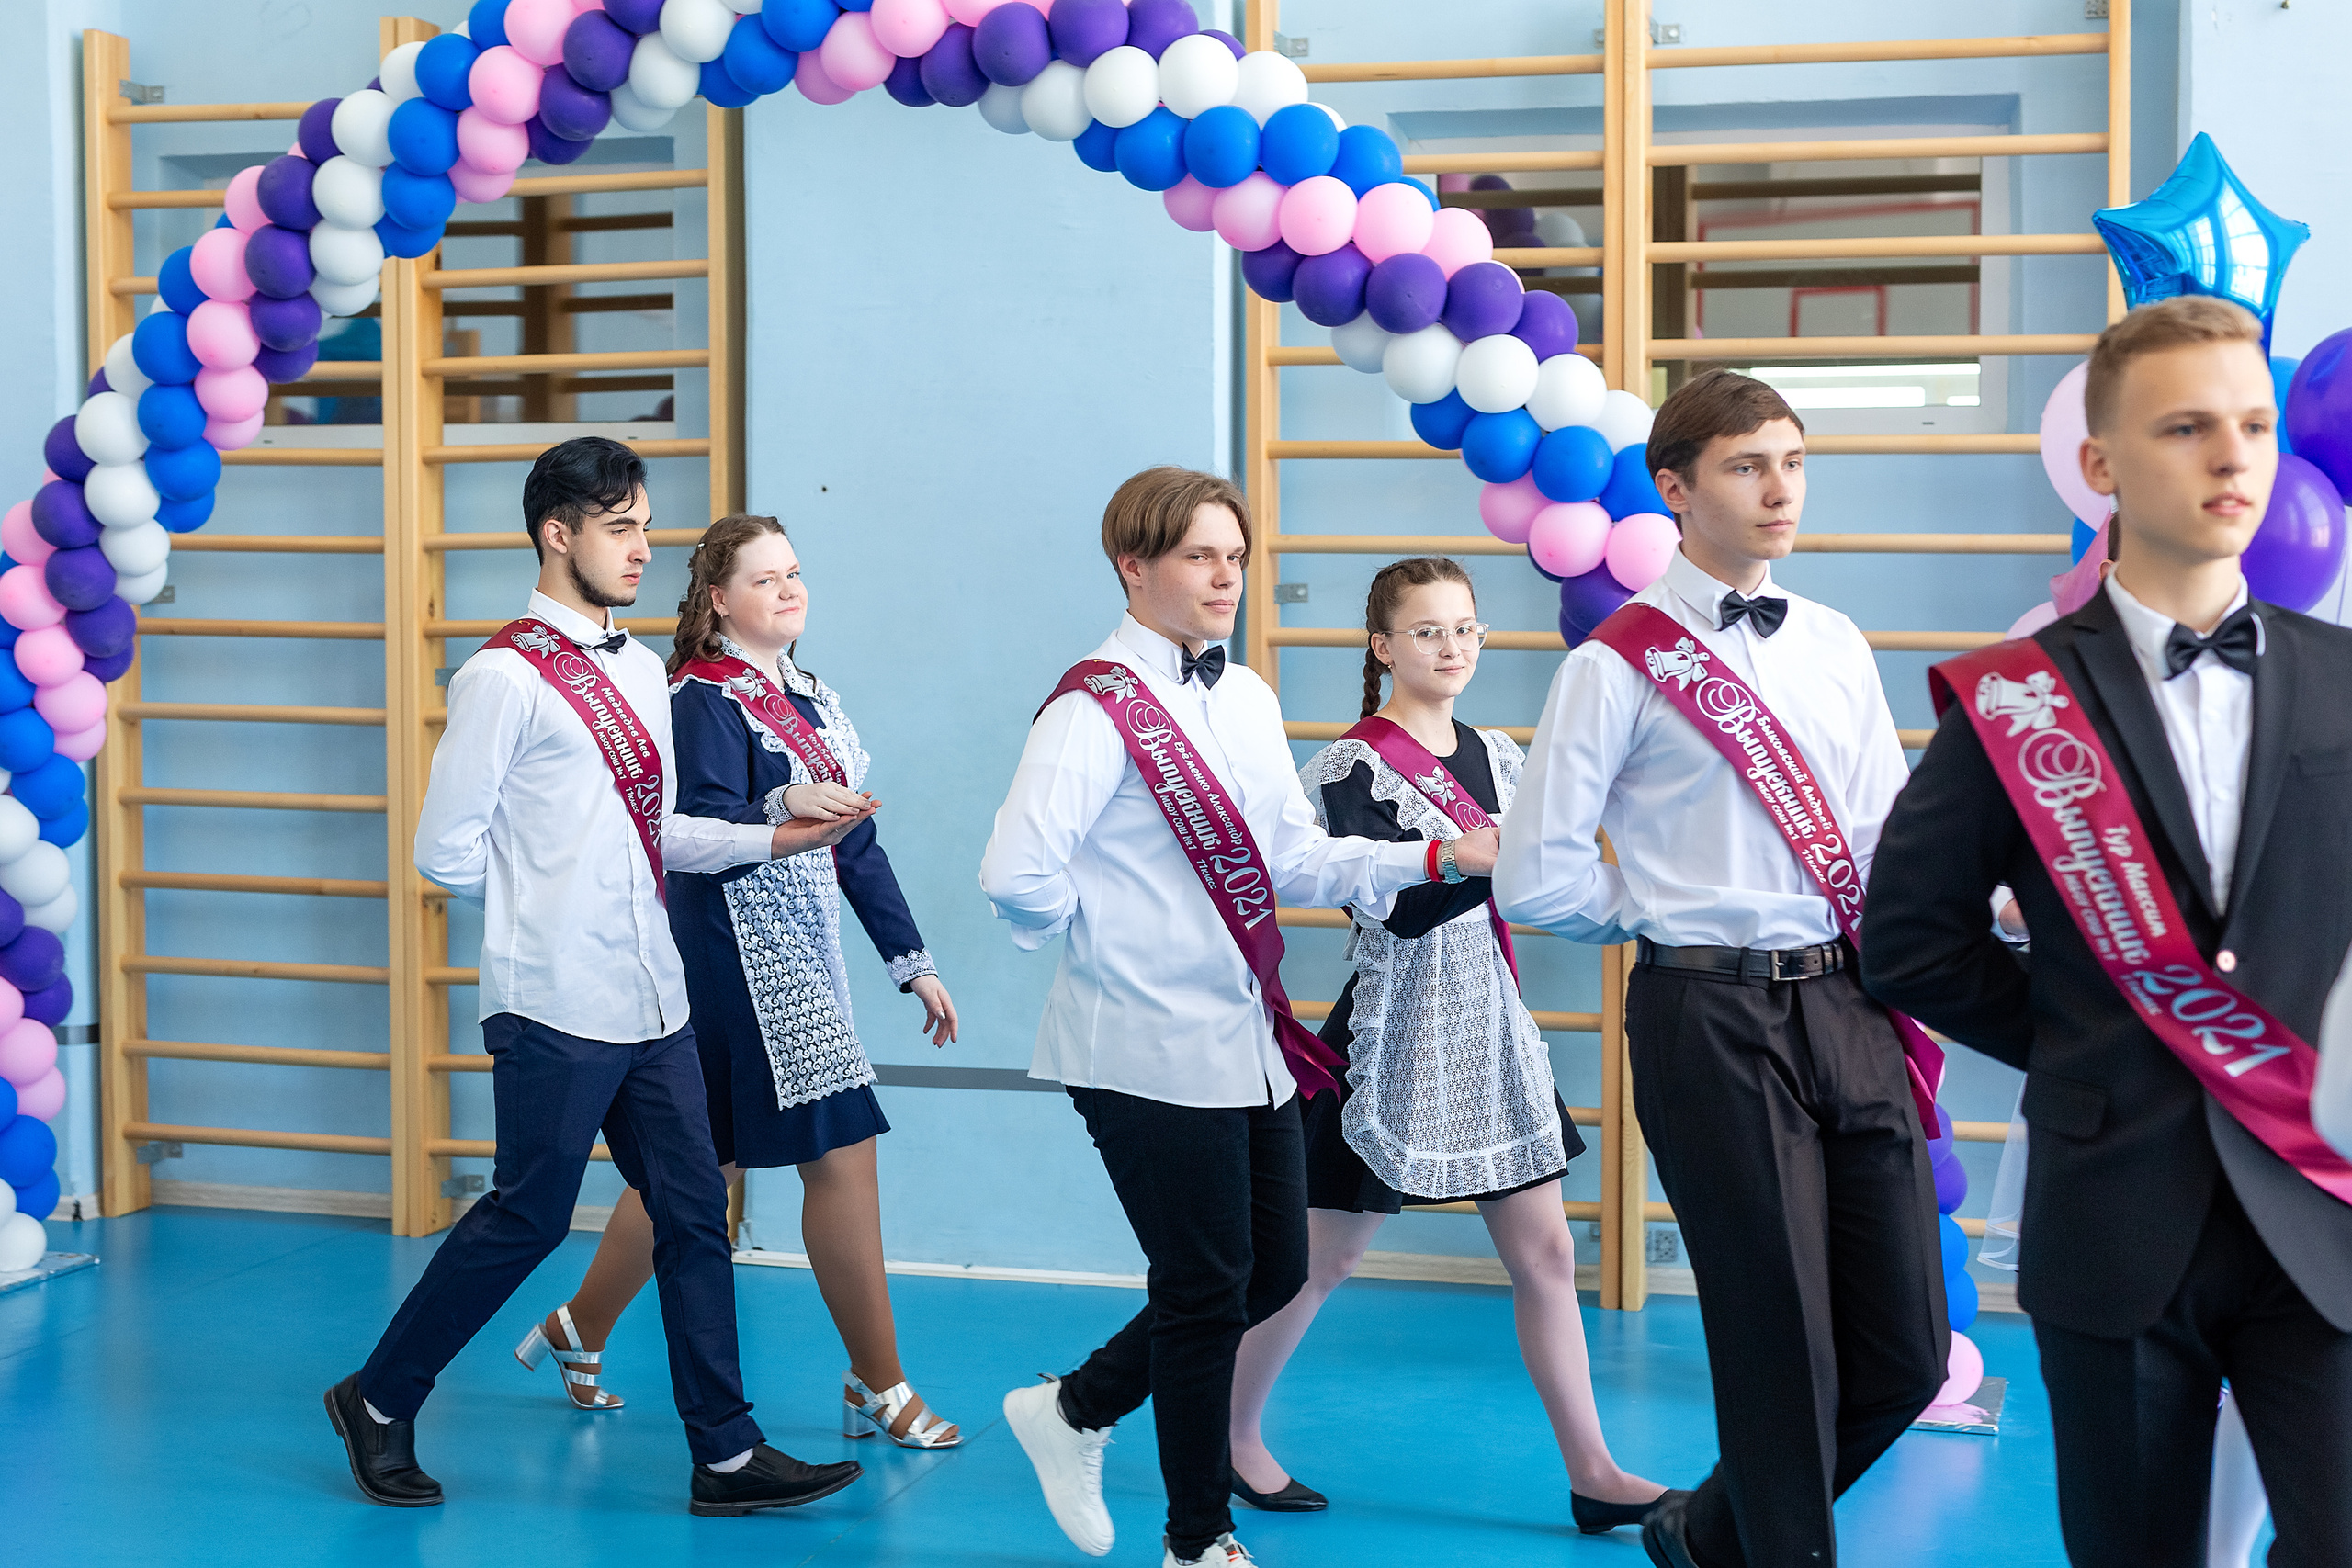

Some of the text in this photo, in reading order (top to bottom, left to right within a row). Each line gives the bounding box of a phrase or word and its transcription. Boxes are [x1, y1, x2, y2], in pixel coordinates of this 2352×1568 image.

[553, 651, 662, 848] Выпускник 2021
[597, 731, 613, 750] МБОУ
[608, 750, 620, 766] СОШ
[601, 686, 650, 758] Медведев Лев
[807, 733, 837, 770] Корбань
[1696, 676, 1818, 840] Выпускник
[1756, 714, 1834, 830] Быковский Андрей
[1126, 699, 1273, 931] Выпускник 2021
[1159, 795, 1179, 818] МБОУ
[1172, 817, 1191, 836] СОШ
[1196, 858, 1217, 890] 11класс
[1173, 741, 1243, 845] Ерёменко Александр
[1755, 781, 1777, 804] МБОУ
[1771, 805, 1789, 824] СОШ
[2018, 728, 2291, 1077] Выпускник 2021
[2102, 824, 2133, 858] Тур
[2120, 861, 2167, 938] Максим
